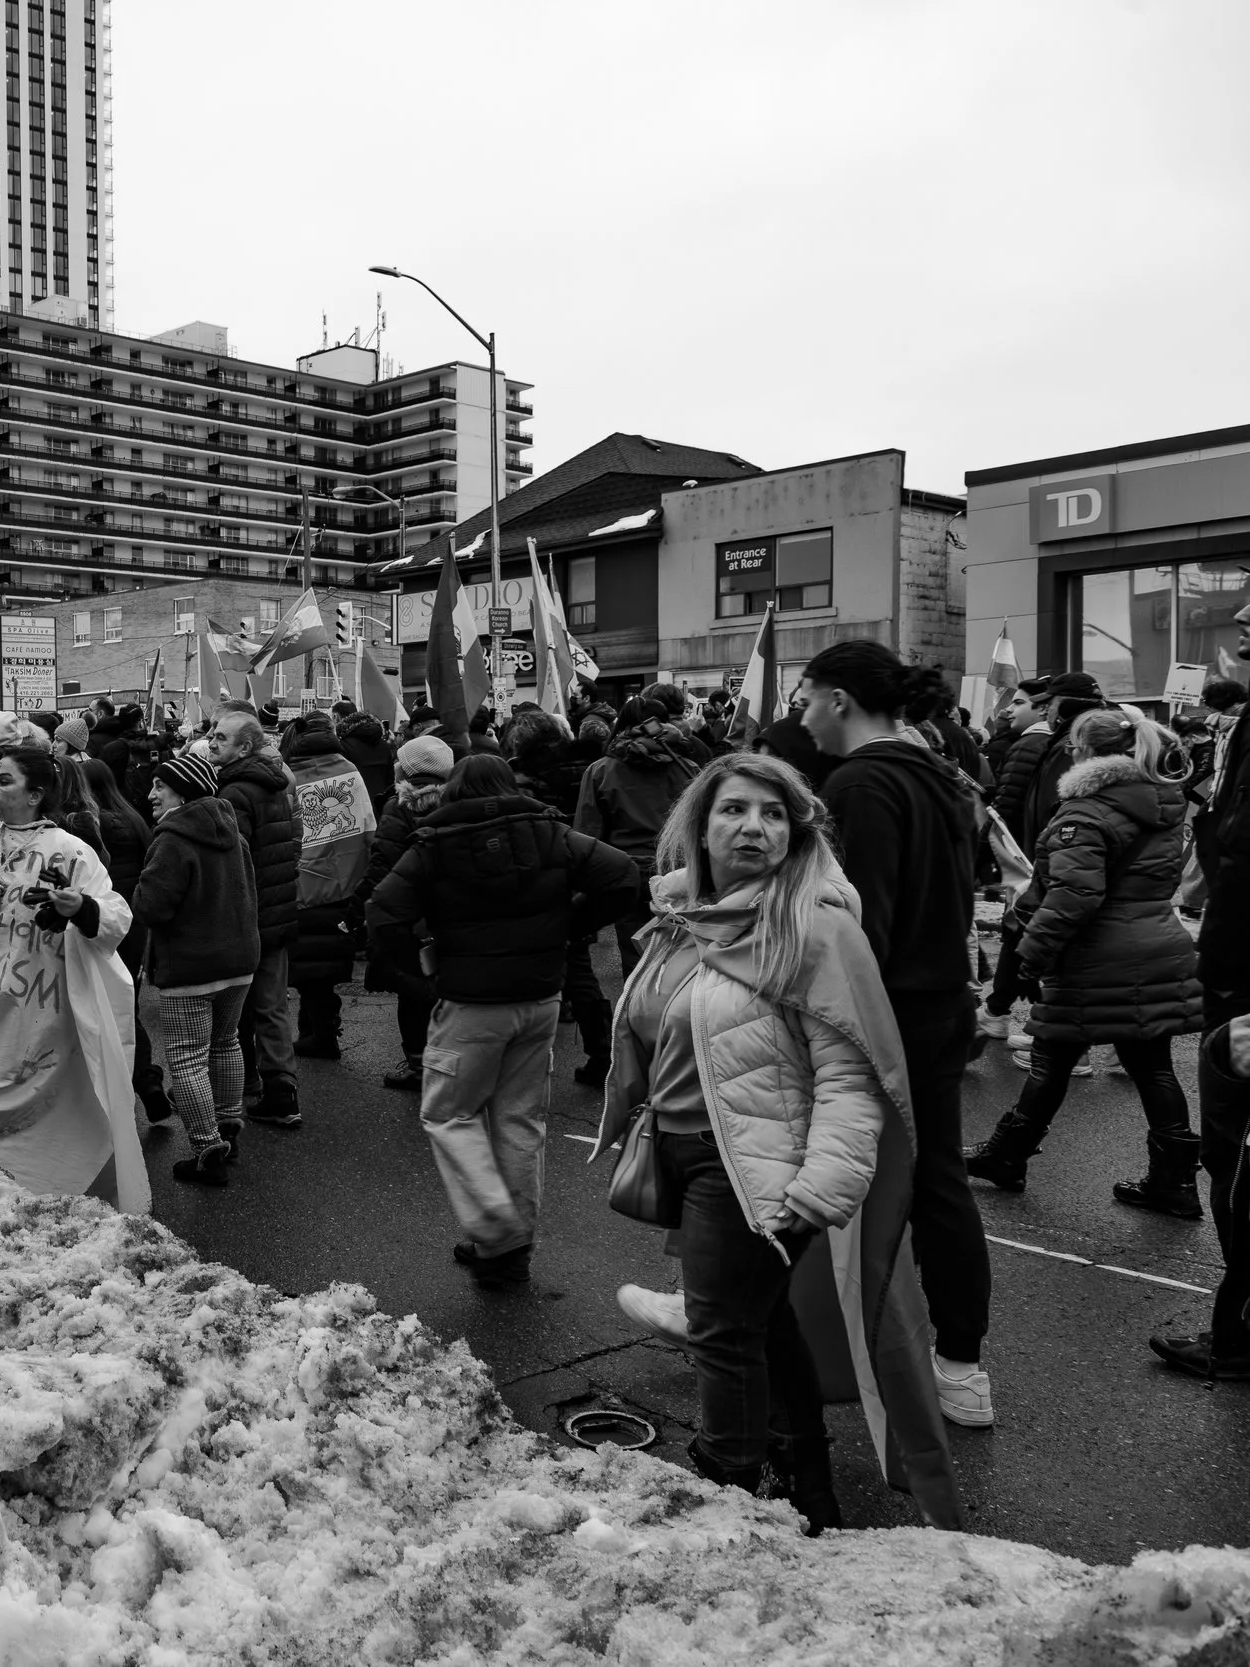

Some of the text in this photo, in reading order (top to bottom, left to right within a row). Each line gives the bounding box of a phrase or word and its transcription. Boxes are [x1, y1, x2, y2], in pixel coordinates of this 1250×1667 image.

[1045, 487, 1102, 528] TD
[725, 548, 767, 561] Entrance
[728, 558, 763, 571] at Rear
